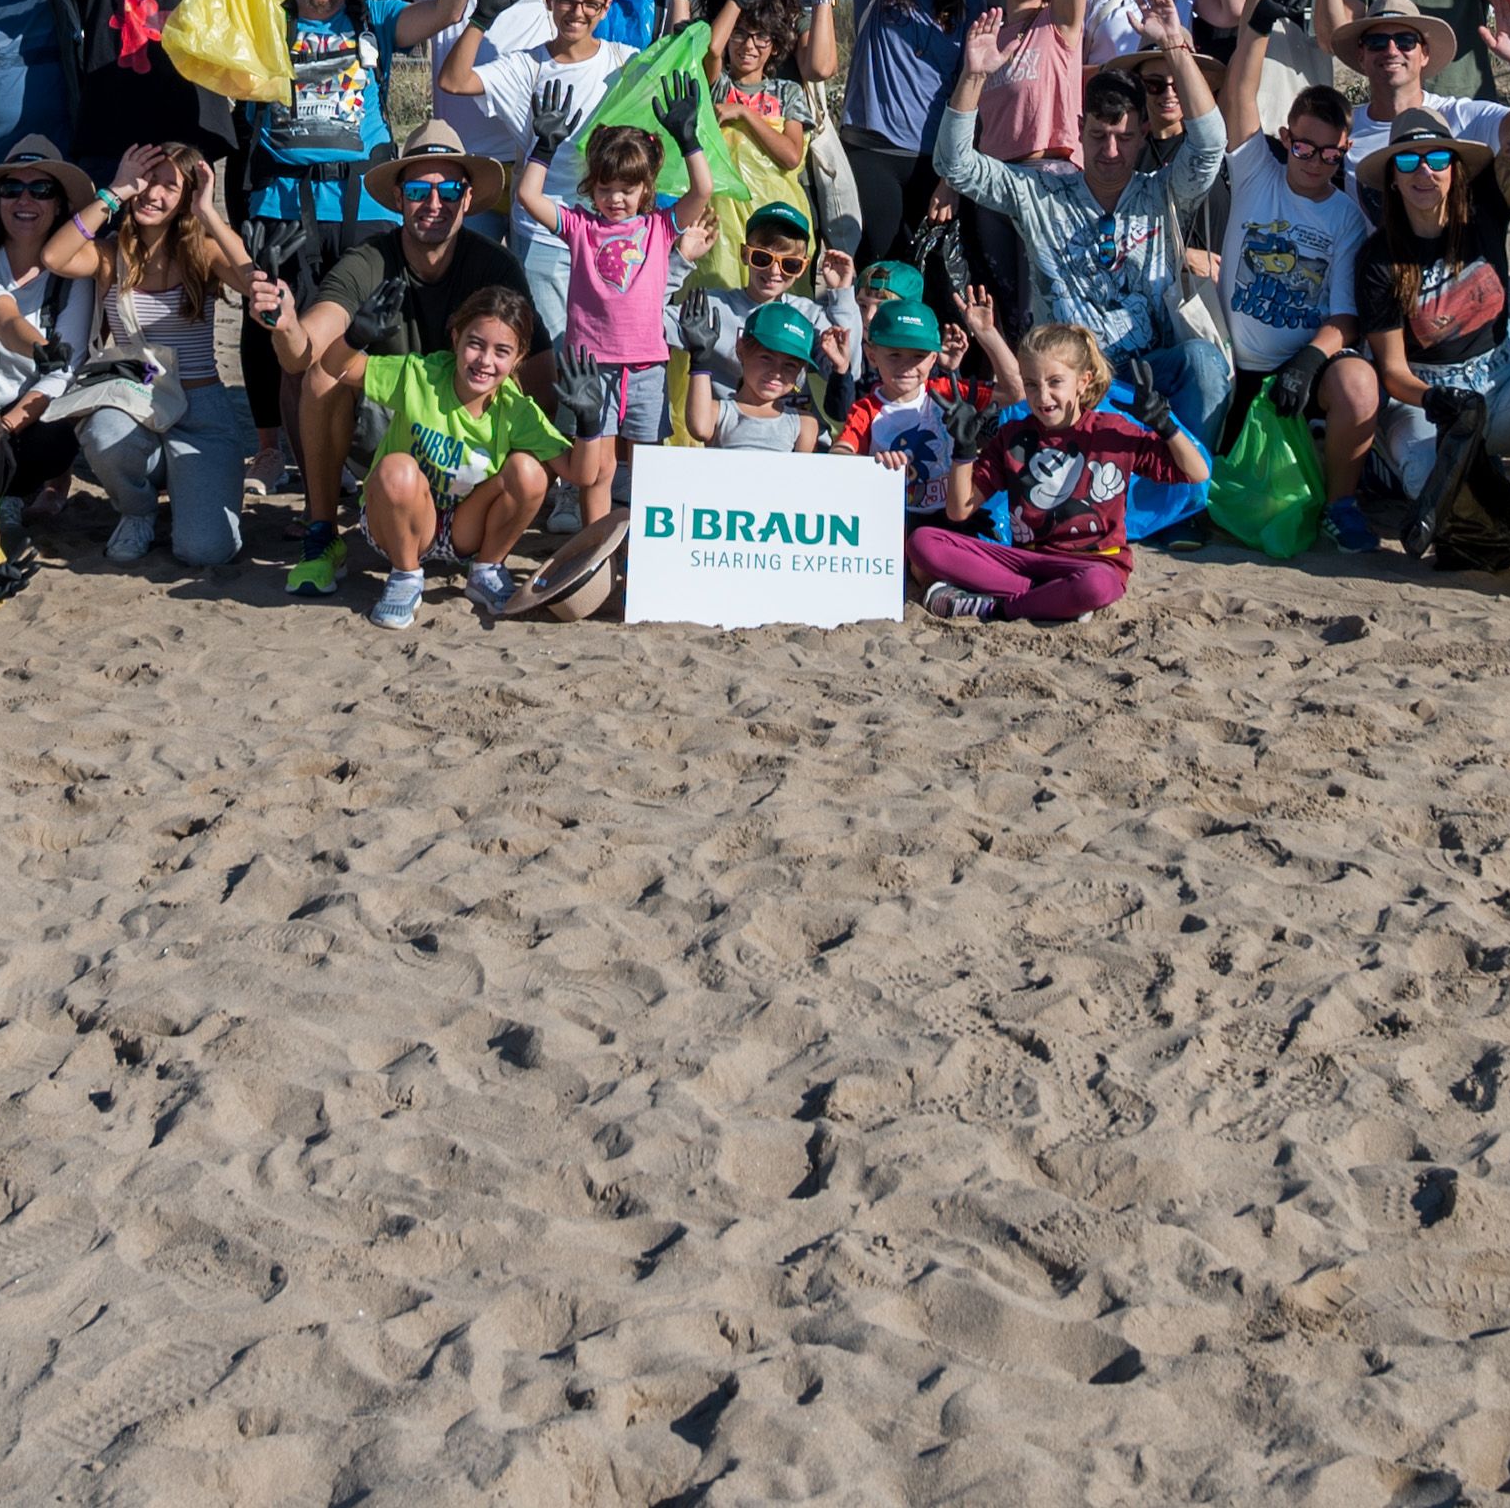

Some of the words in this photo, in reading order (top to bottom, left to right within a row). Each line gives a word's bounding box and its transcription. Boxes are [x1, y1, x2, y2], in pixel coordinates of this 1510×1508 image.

[644, 505, 675, 539] B
[692, 508, 861, 547] BRAUN
[691, 549, 782, 572] SHARING
[791, 554, 896, 576] EXPERTISE
